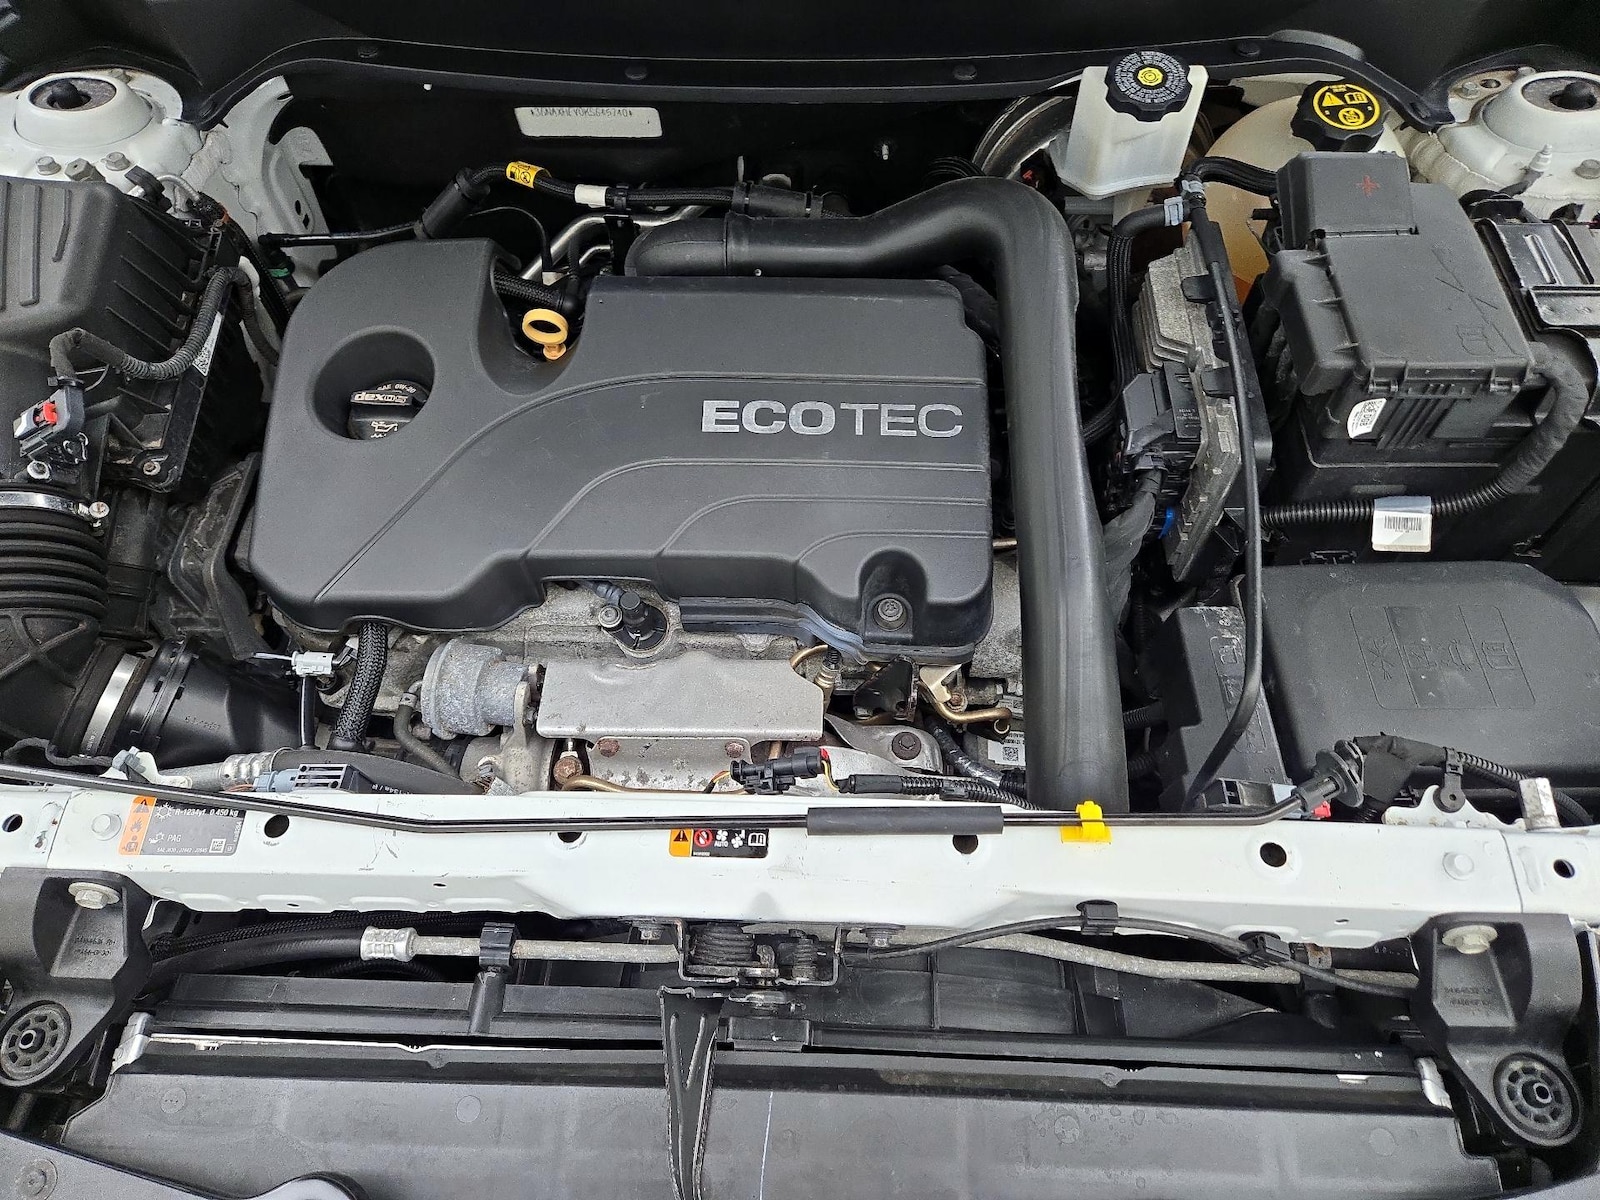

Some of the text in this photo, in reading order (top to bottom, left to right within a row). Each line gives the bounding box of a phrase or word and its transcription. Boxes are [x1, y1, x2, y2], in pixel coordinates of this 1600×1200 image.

[354, 392, 408, 403] dexos
[701, 400, 963, 438] ECOTEC
[229, 809, 239, 818] kg
[167, 834, 182, 843] PAG
[714, 840, 729, 848] AUTO
